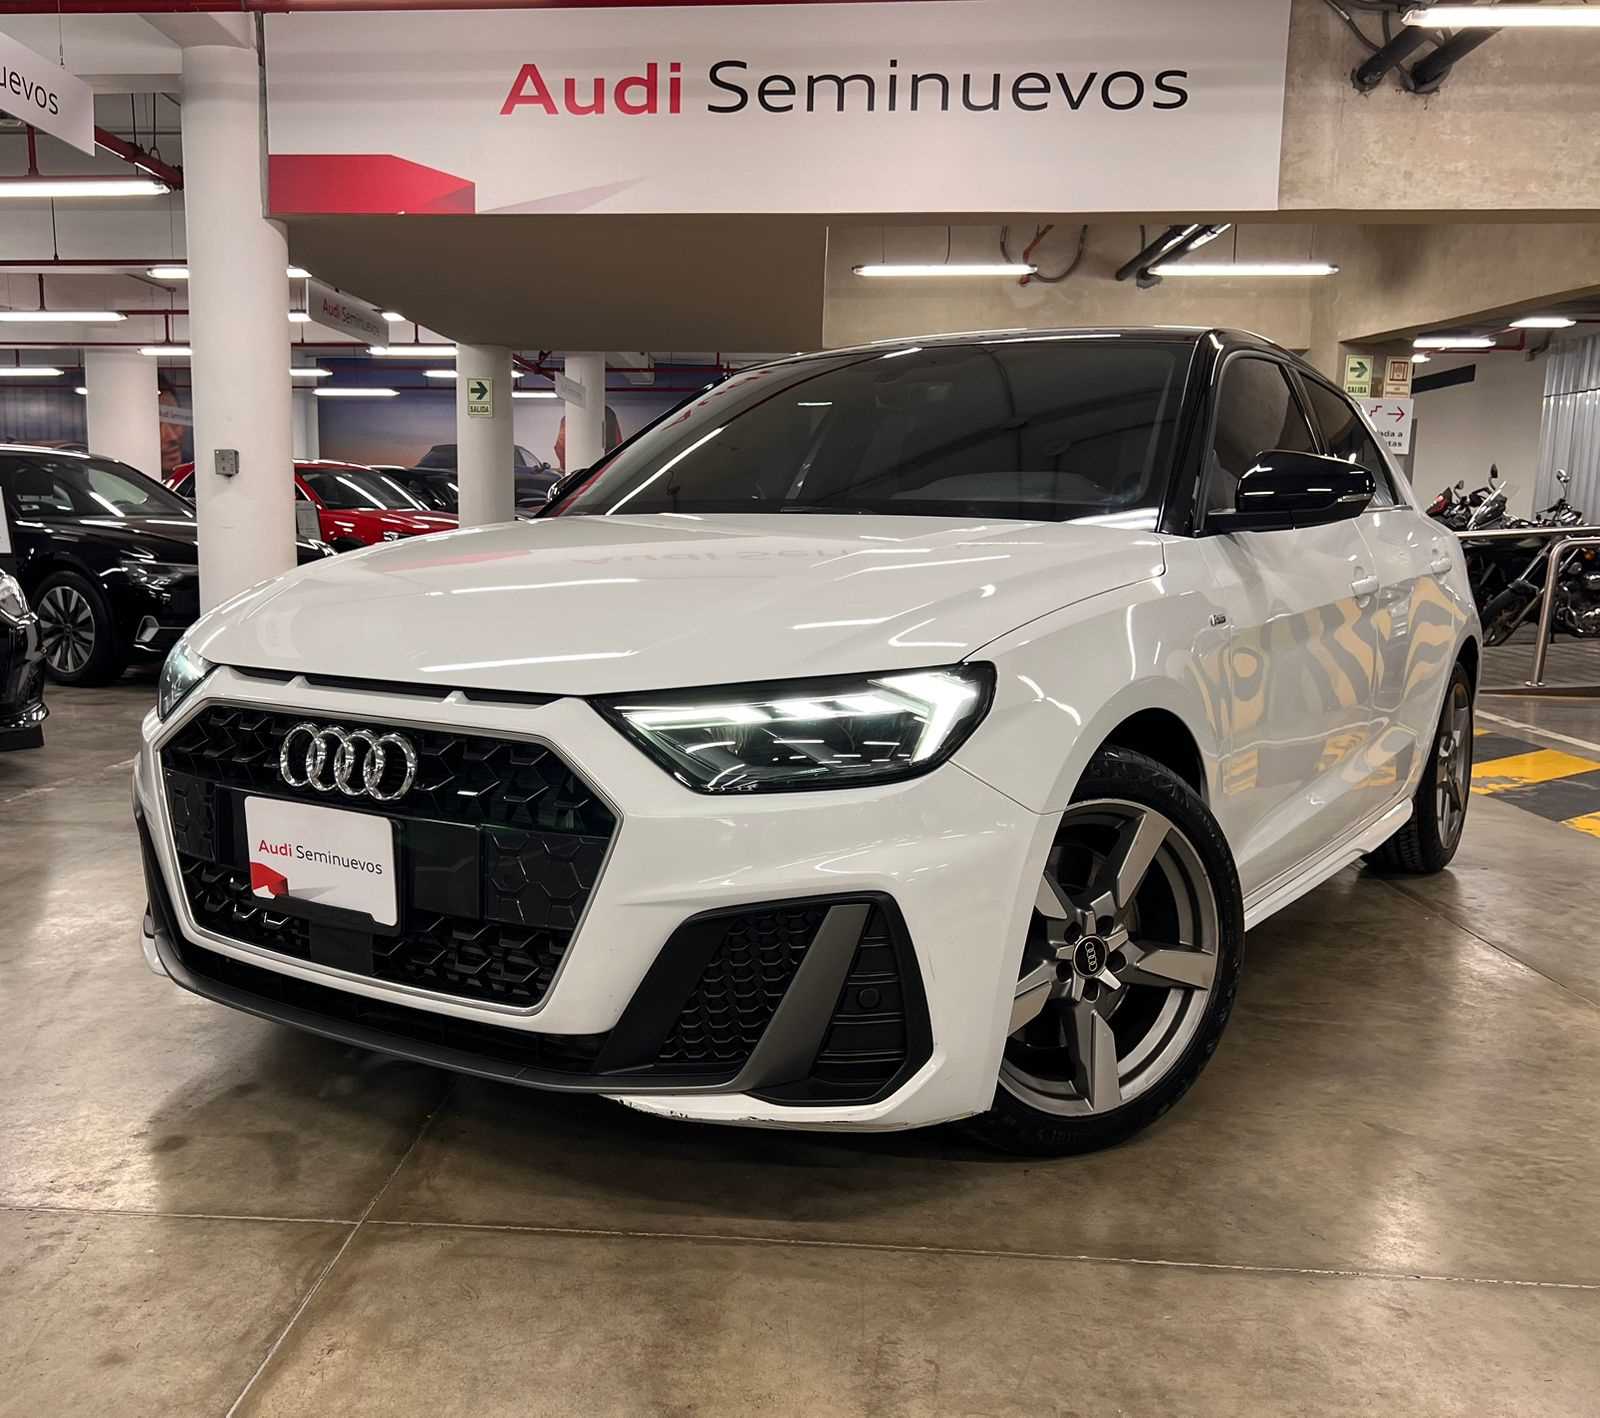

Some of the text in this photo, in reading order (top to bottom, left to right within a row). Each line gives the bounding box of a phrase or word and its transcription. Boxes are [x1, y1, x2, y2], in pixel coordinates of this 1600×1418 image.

[500, 59, 1189, 115] Audi Seminuevos
[1347, 386, 1367, 394] SALIDA
[470, 405, 489, 413] SALIDA
[258, 839, 383, 875] Audi Seminuevos
